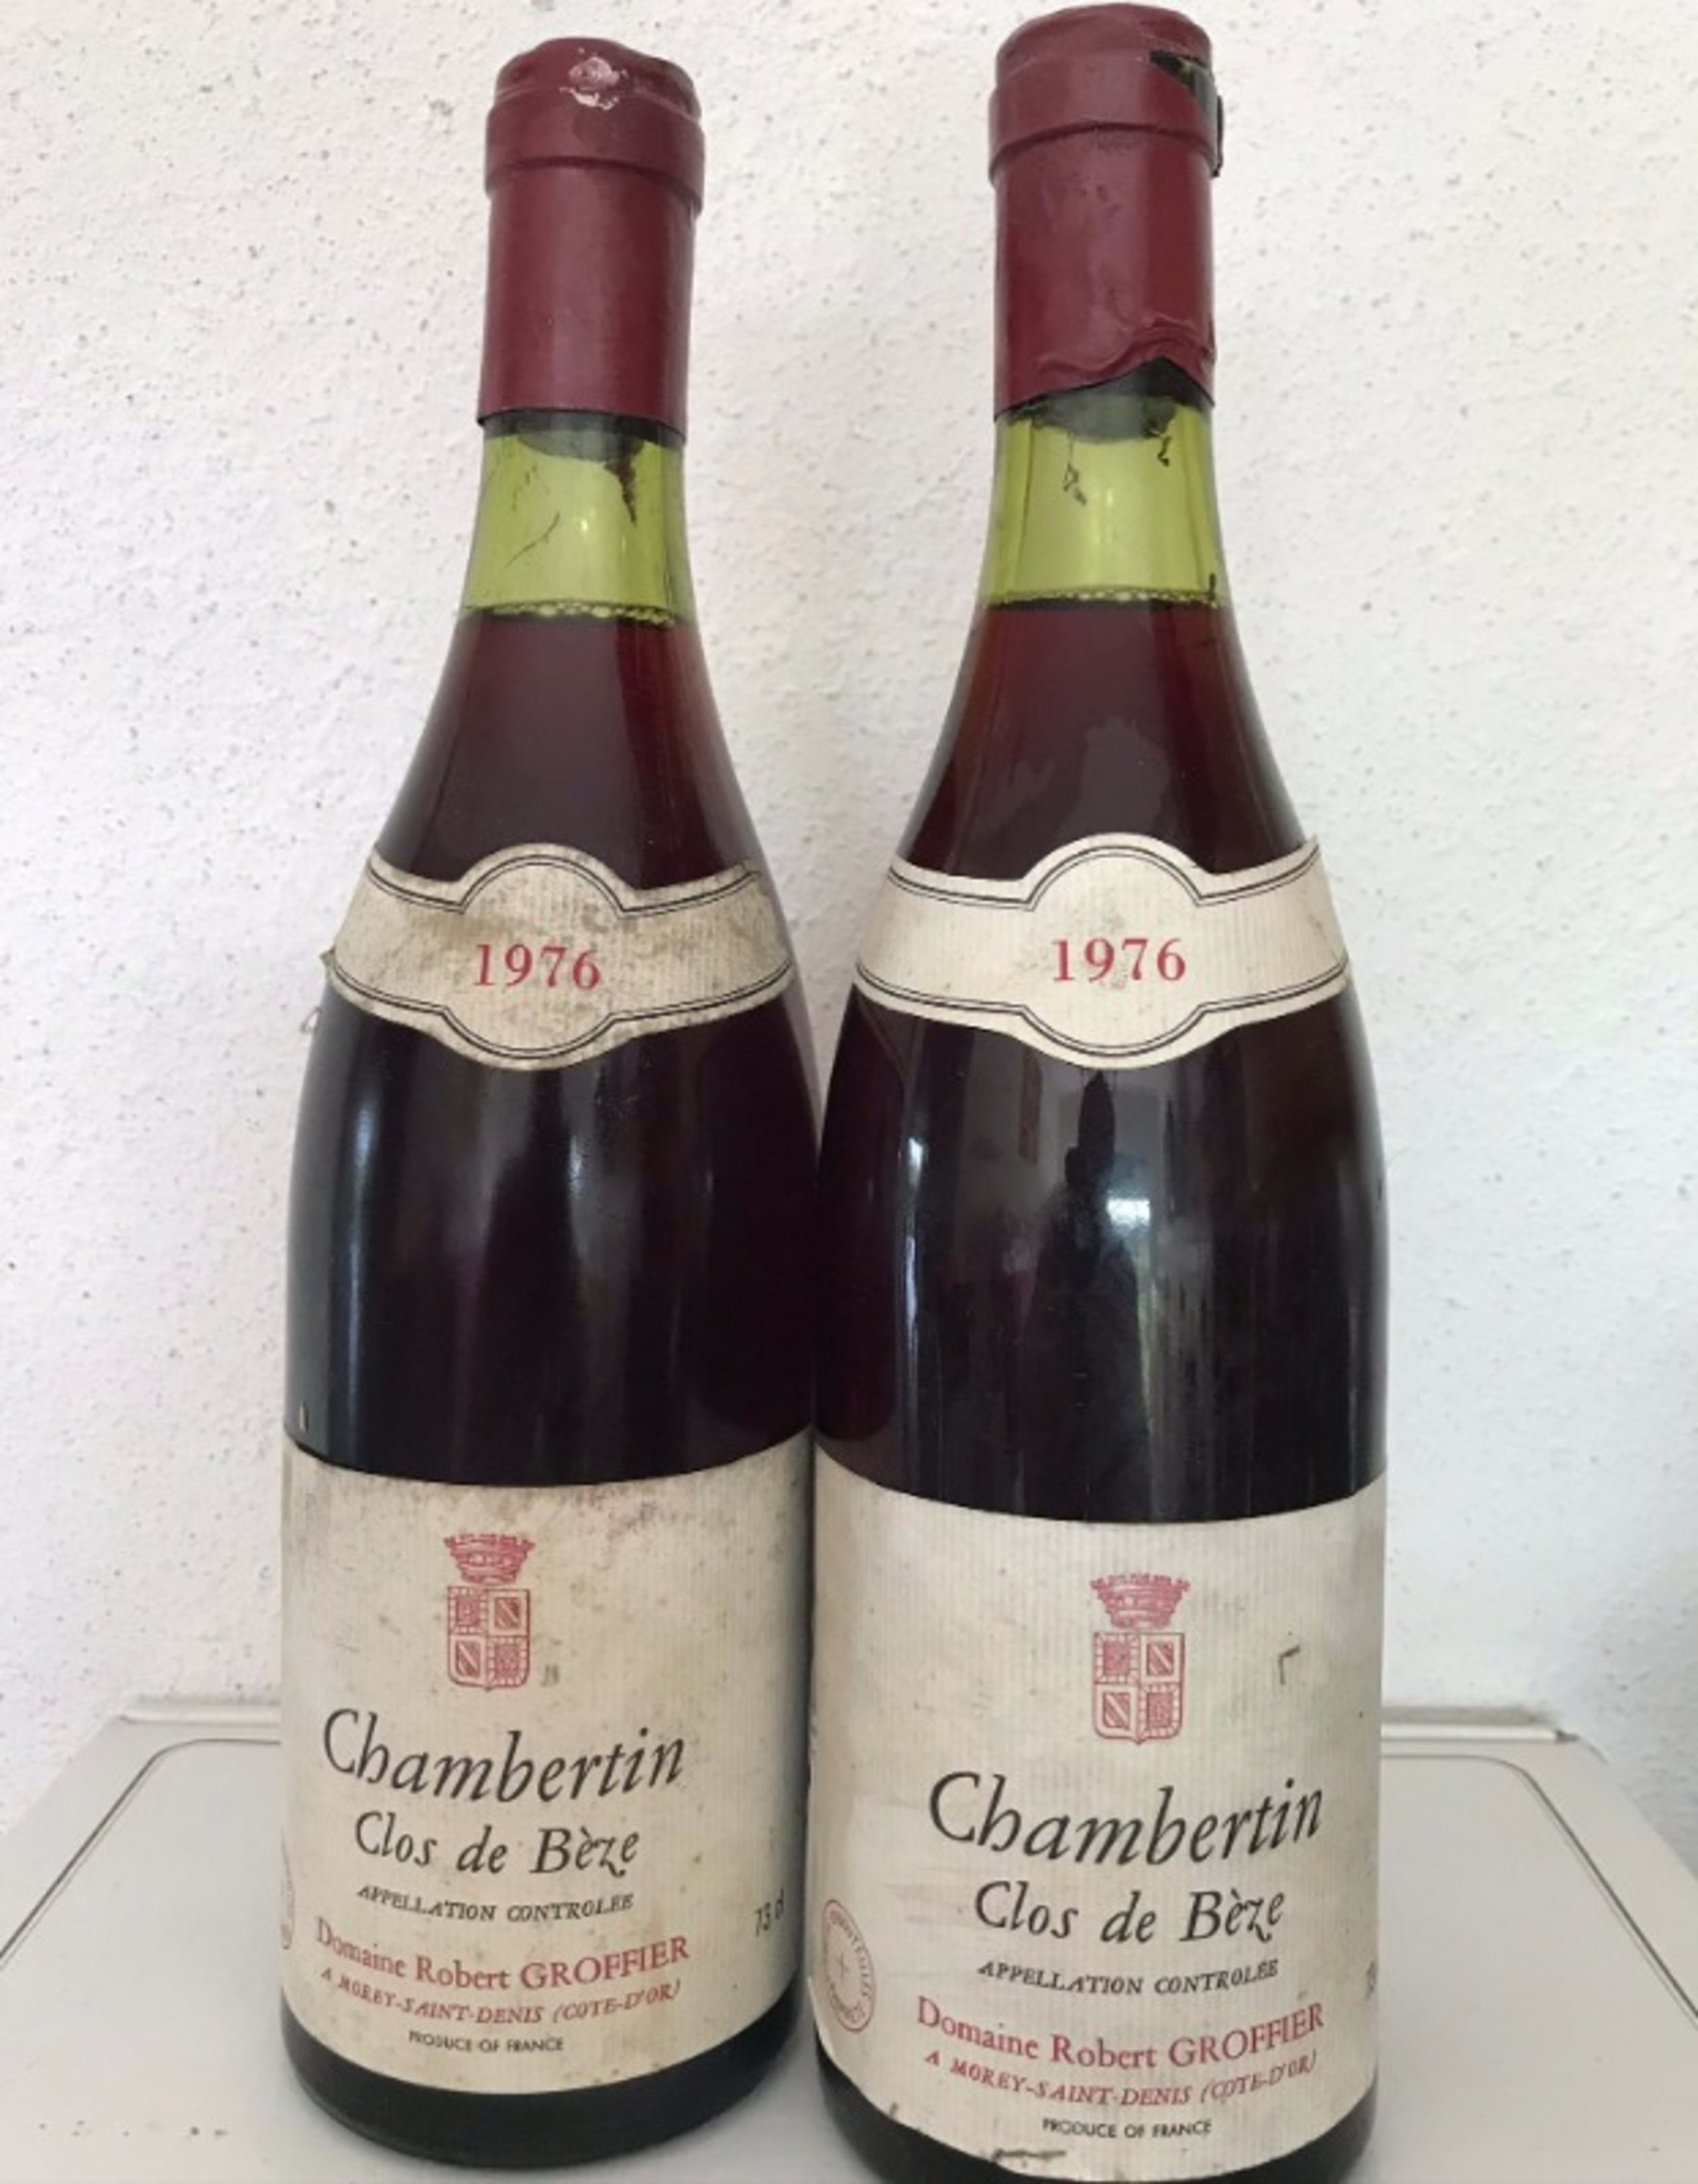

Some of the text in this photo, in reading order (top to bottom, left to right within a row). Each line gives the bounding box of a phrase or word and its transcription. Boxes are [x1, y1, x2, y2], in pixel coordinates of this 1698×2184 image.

[474, 943, 602, 991] 1976
[1053, 937, 1187, 982] 1976
[323, 1708, 685, 1803] Chambertin
[354, 1810, 640, 1878] Clos de Bèze
[929, 1770, 1323, 1866] Chambertin
[358, 1885, 496, 1921] APPELLATION
[974, 1880, 1285, 1943] Clos de Bèze
[314, 1916, 690, 1990] Domaine Robert GROFFIER
[978, 1960, 1144, 1994] APPELLATION
[337, 1976, 545, 2025] MOREY-SAINT-DENIS
[408, 2030, 564, 2052] PRODUCE OF FRANCE
[917, 1994, 1325, 2069] Domaine Robert GROFFIER
[925, 2050, 941, 2066] A
[950, 2058, 1193, 2106] MOREY-SAINT-DENIS
[1042, 2118, 1212, 2138] PRODUCE OF FRANCE
